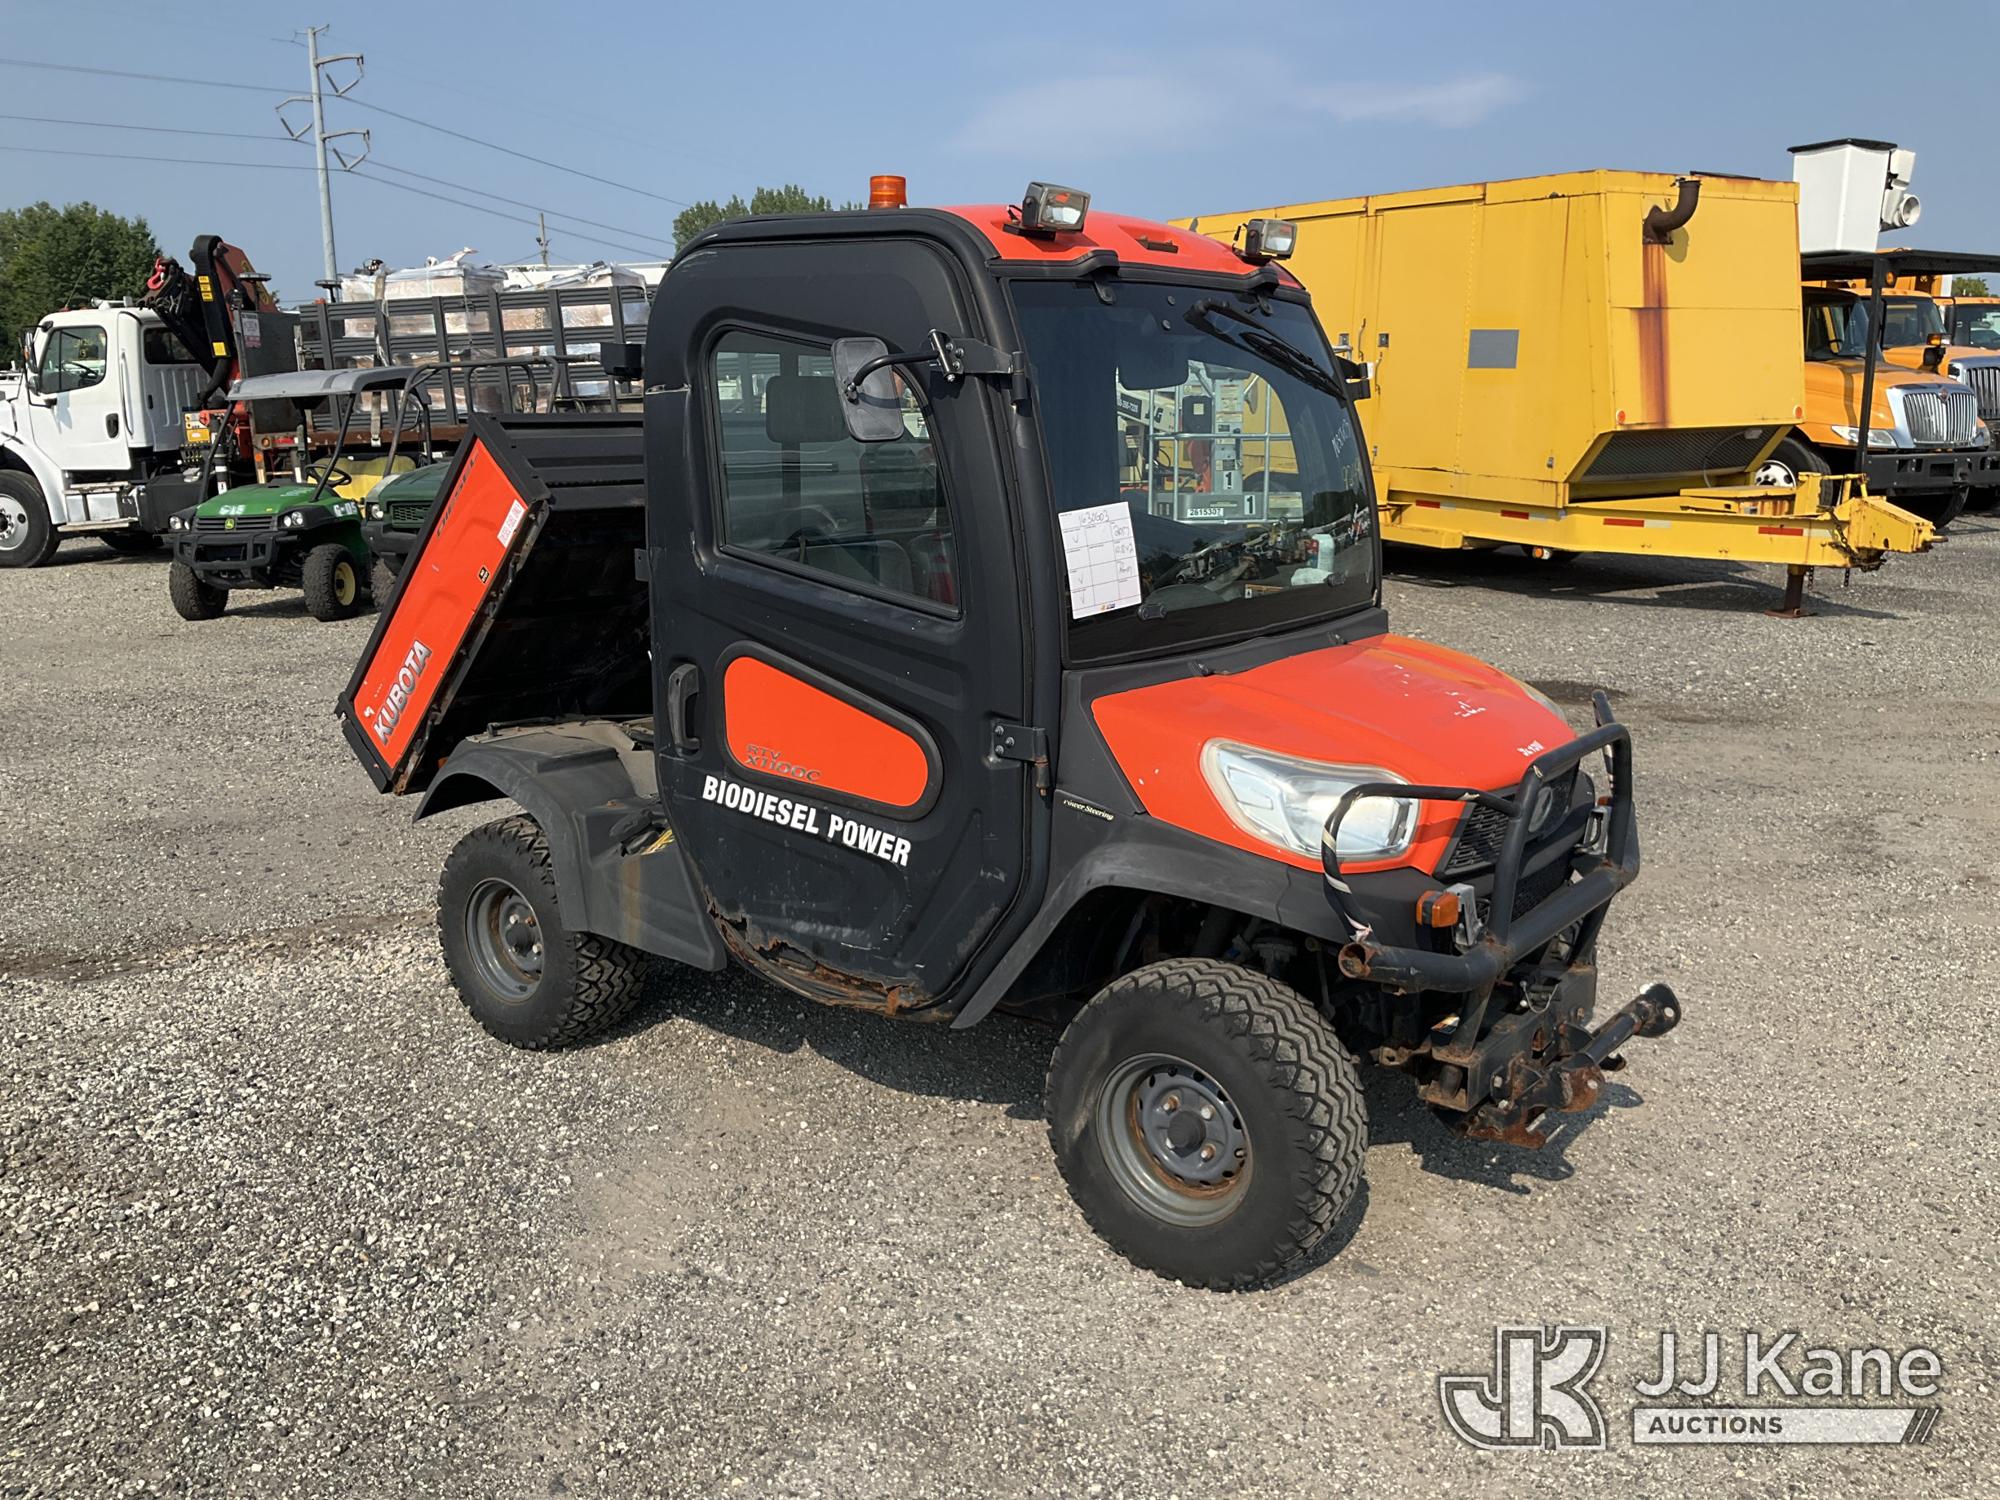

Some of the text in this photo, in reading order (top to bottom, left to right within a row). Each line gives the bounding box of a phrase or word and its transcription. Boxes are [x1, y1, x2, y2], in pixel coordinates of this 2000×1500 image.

[1246, 496, 1253, 514] 1
[373, 640, 432, 745] KUBOTA
[745, 744, 781, 759] RTV
[702, 775, 912, 867] BIODIESEL POWER
